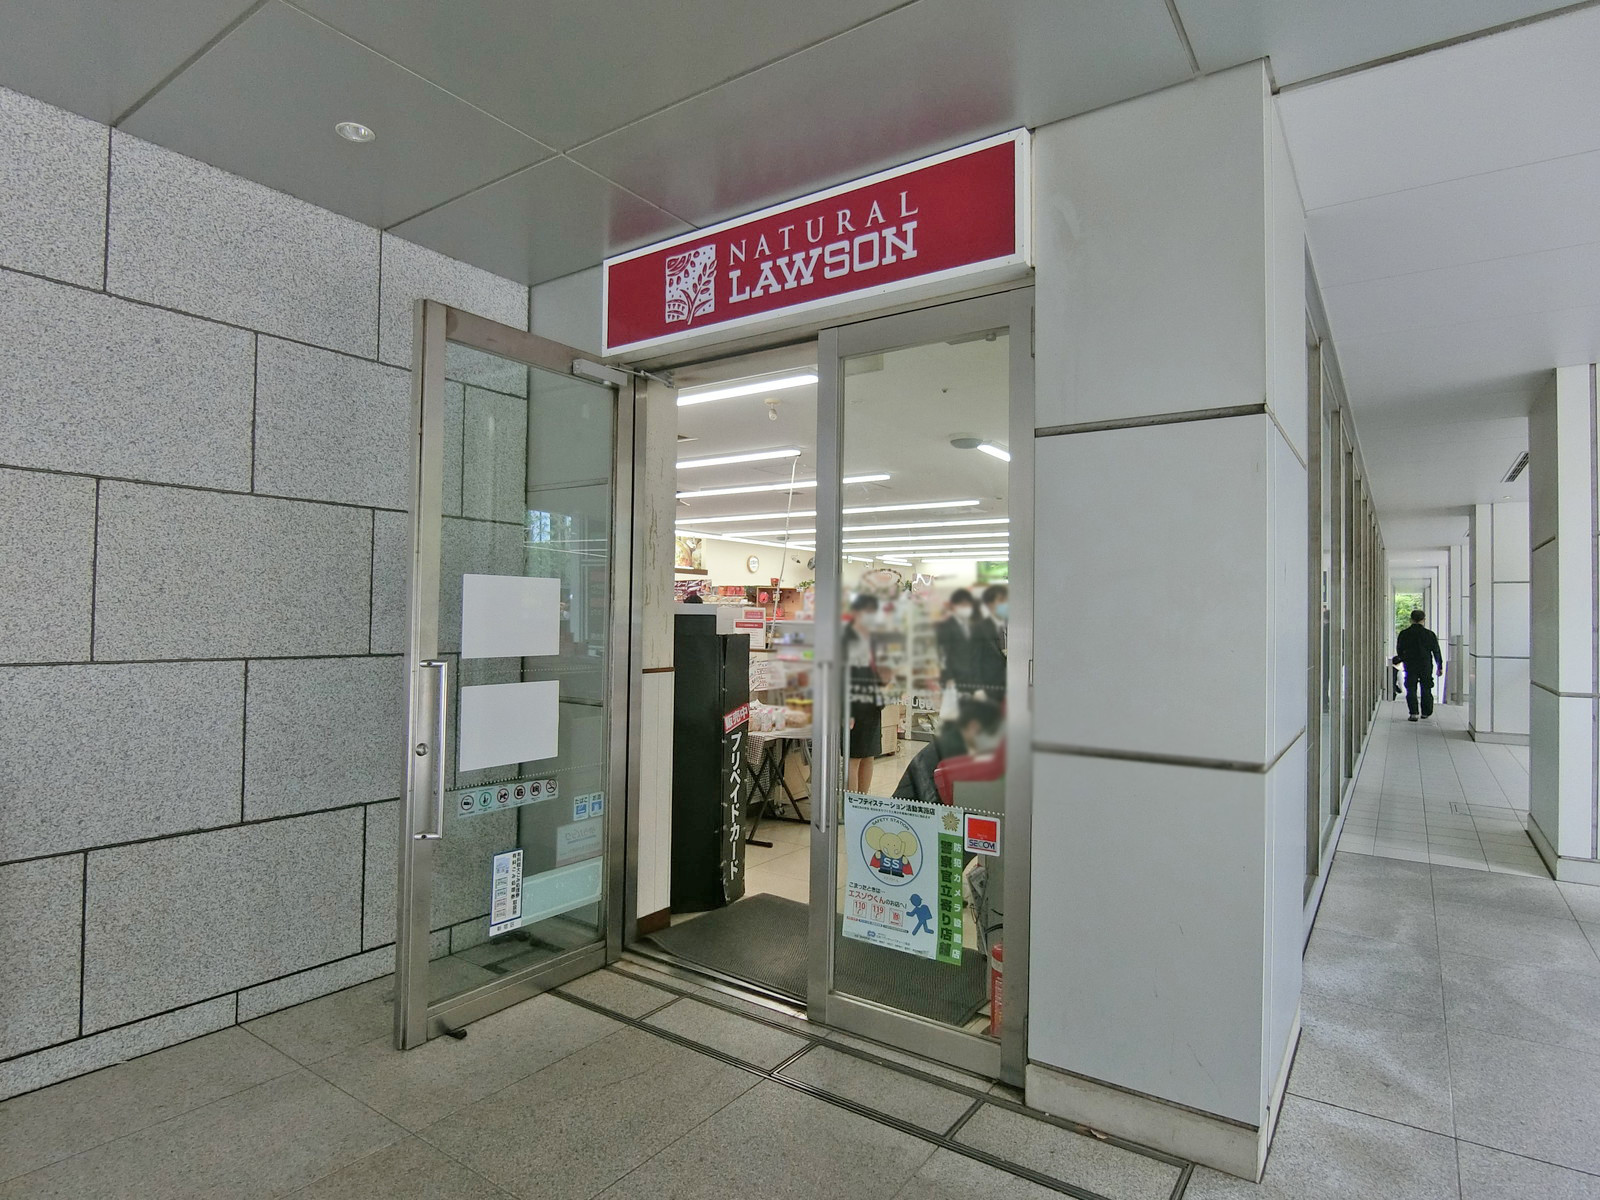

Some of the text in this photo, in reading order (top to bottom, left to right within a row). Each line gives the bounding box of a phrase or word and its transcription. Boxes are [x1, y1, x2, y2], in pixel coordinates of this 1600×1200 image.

[729, 191, 919, 265] NATURAL
[729, 220, 918, 304] LAWSON
[574, 796, 588, 805] たばこ
[729, 732, 743, 881] プリペイドカード
[847, 796, 936, 816] セーフティステーション活動実施店
[871, 817, 910, 831] SAFETY STATION
[968, 839, 996, 850] SECOM
[883, 857, 900, 869] SS
[855, 900, 866, 910] 110
[873, 905, 884, 914] 119
